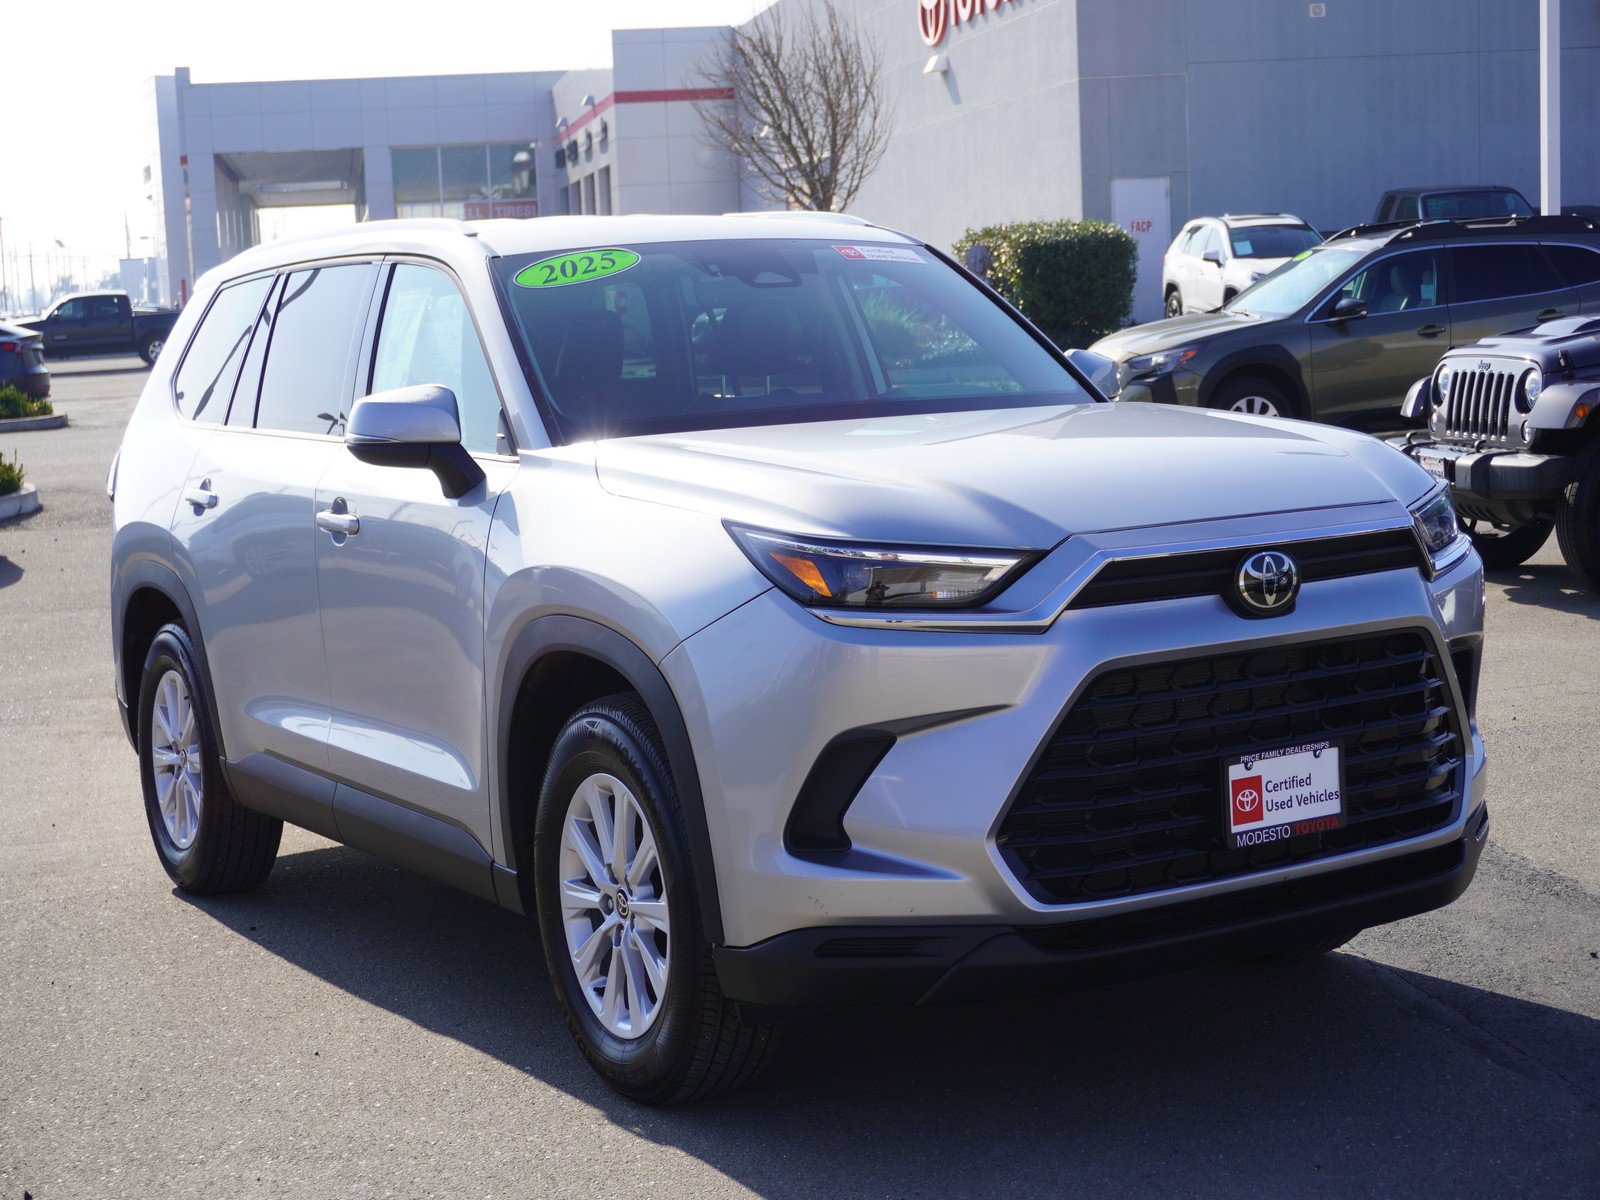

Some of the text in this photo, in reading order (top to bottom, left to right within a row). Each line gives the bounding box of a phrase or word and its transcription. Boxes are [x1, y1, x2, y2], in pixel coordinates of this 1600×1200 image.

[539, 251, 616, 285] 2025
[1240, 741, 1330, 763] PRICE FAMILY DEALERSHIPS
[1265, 773, 1312, 793] Certified
[1266, 789, 1340, 812] Used Vehicles
[1236, 816, 1340, 847] MODESTO TOYOTA
